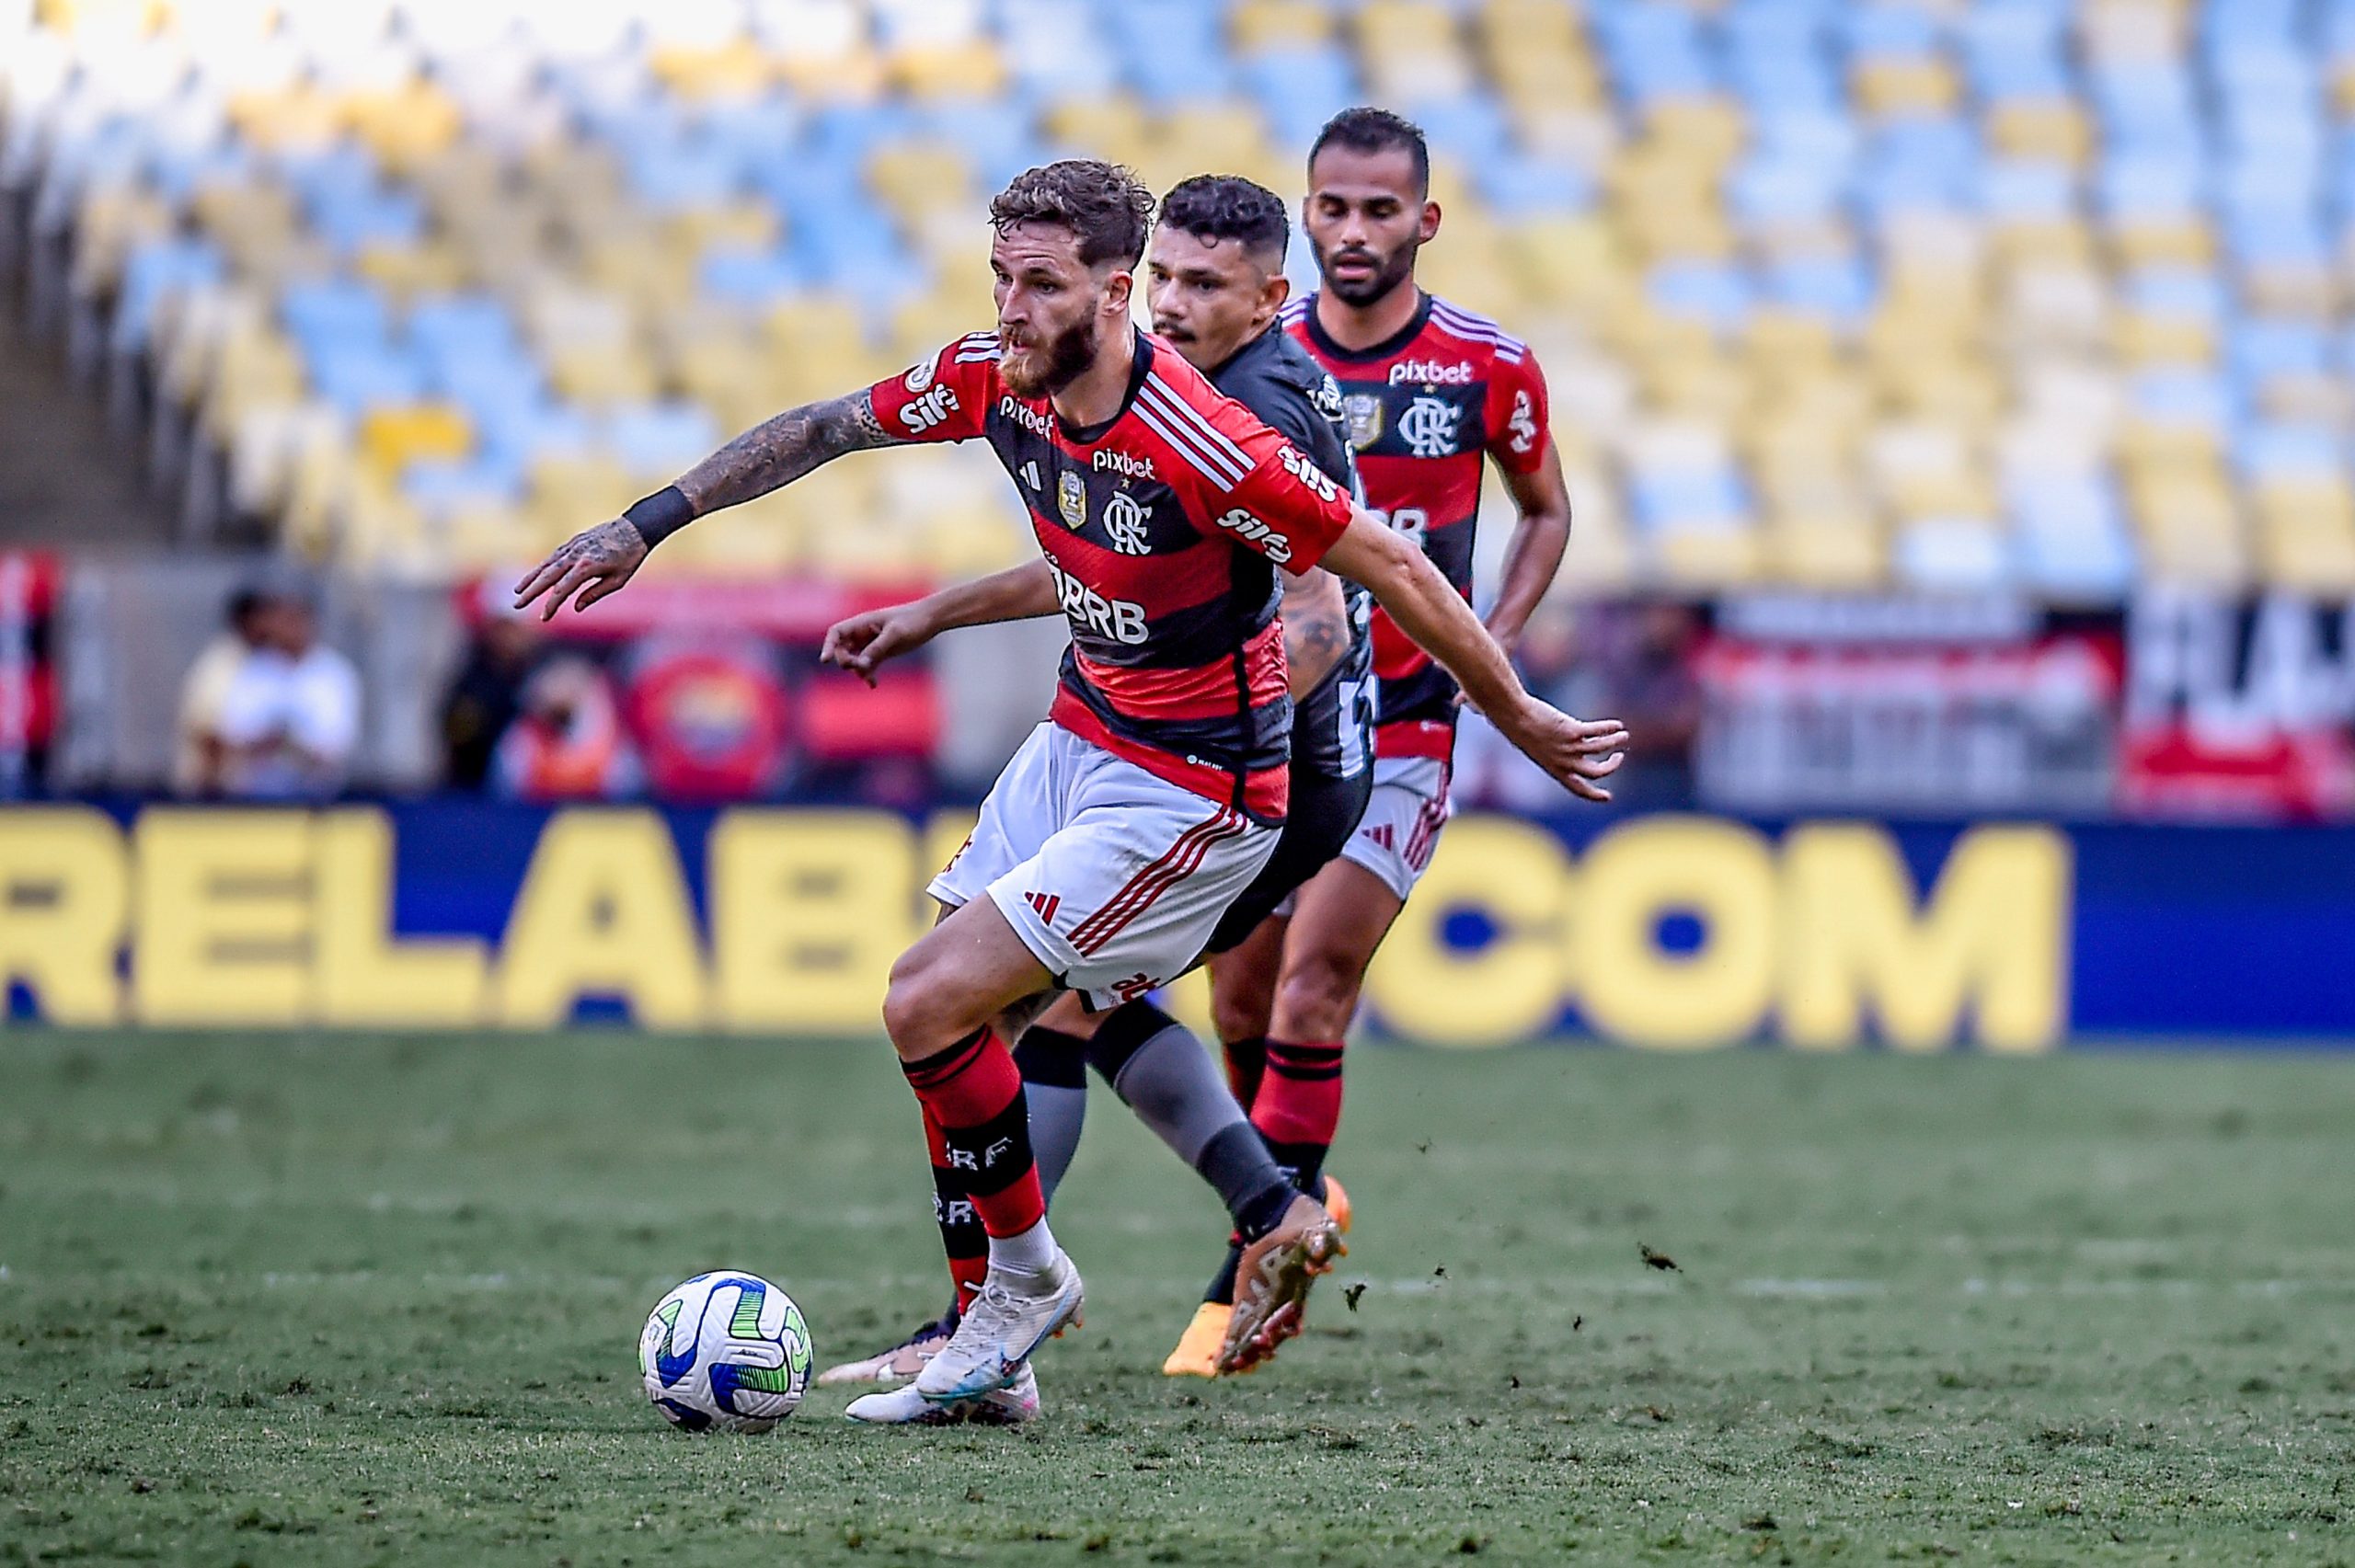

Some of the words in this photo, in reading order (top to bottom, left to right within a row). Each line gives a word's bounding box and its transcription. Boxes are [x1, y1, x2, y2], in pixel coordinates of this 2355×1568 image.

[1389, 360, 1472, 386] pixbet
[1000, 395, 1054, 441] pixbet
[1093, 447, 1156, 480] pixbet
[1062, 571, 1150, 645] BRB
[946, 1137, 1013, 1171] RF
